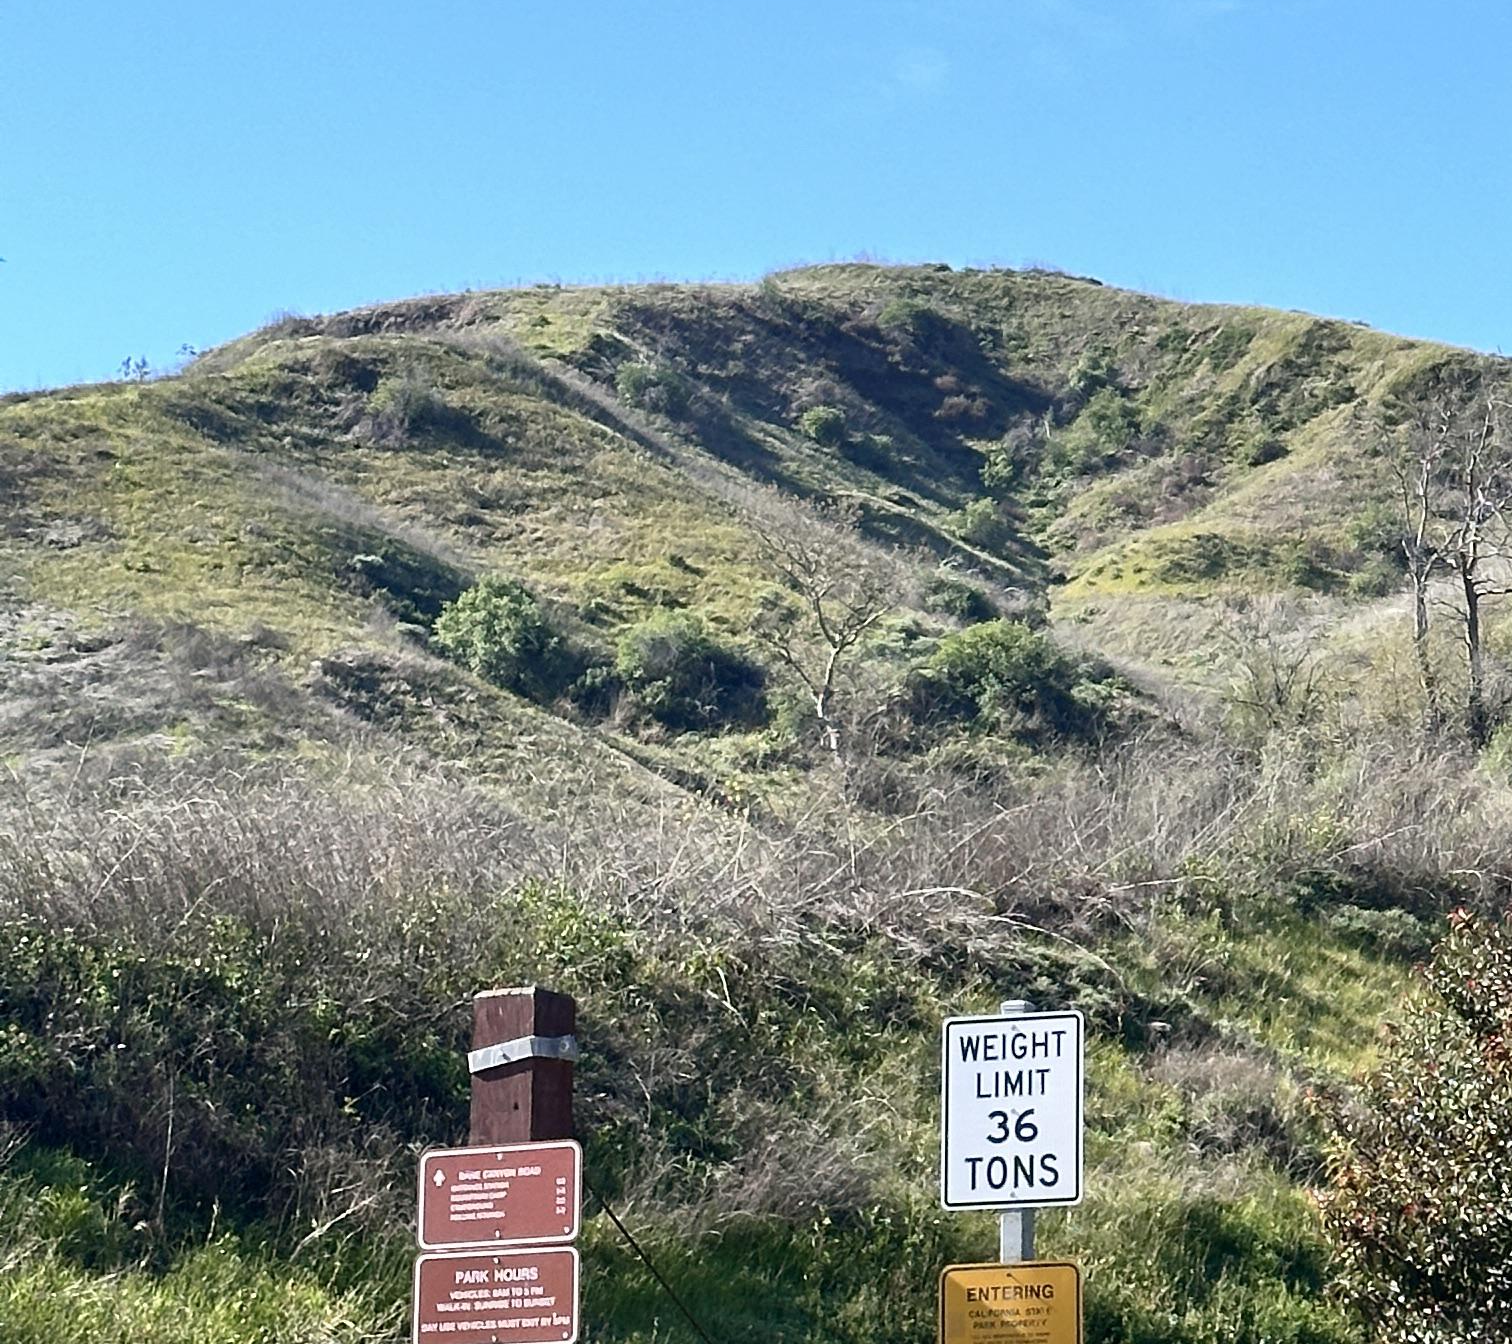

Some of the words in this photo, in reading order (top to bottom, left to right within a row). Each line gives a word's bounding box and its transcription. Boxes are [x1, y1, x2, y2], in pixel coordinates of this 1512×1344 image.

[959, 1031, 1067, 1062] WEIGHT
[976, 1068, 1050, 1098] LIMIT
[986, 1109, 1039, 1144] 36
[964, 1154, 1059, 1190] TONS
[455, 1270, 489, 1284] PARK
[494, 1267, 539, 1282] HOURS
[511, 1287, 523, 1296] TO
[530, 1286, 544, 1295] PM
[966, 1284, 1054, 1302] ENTERING
[511, 1298, 523, 1308] TO
[968, 1307, 1021, 1319] CALIFORNIA
